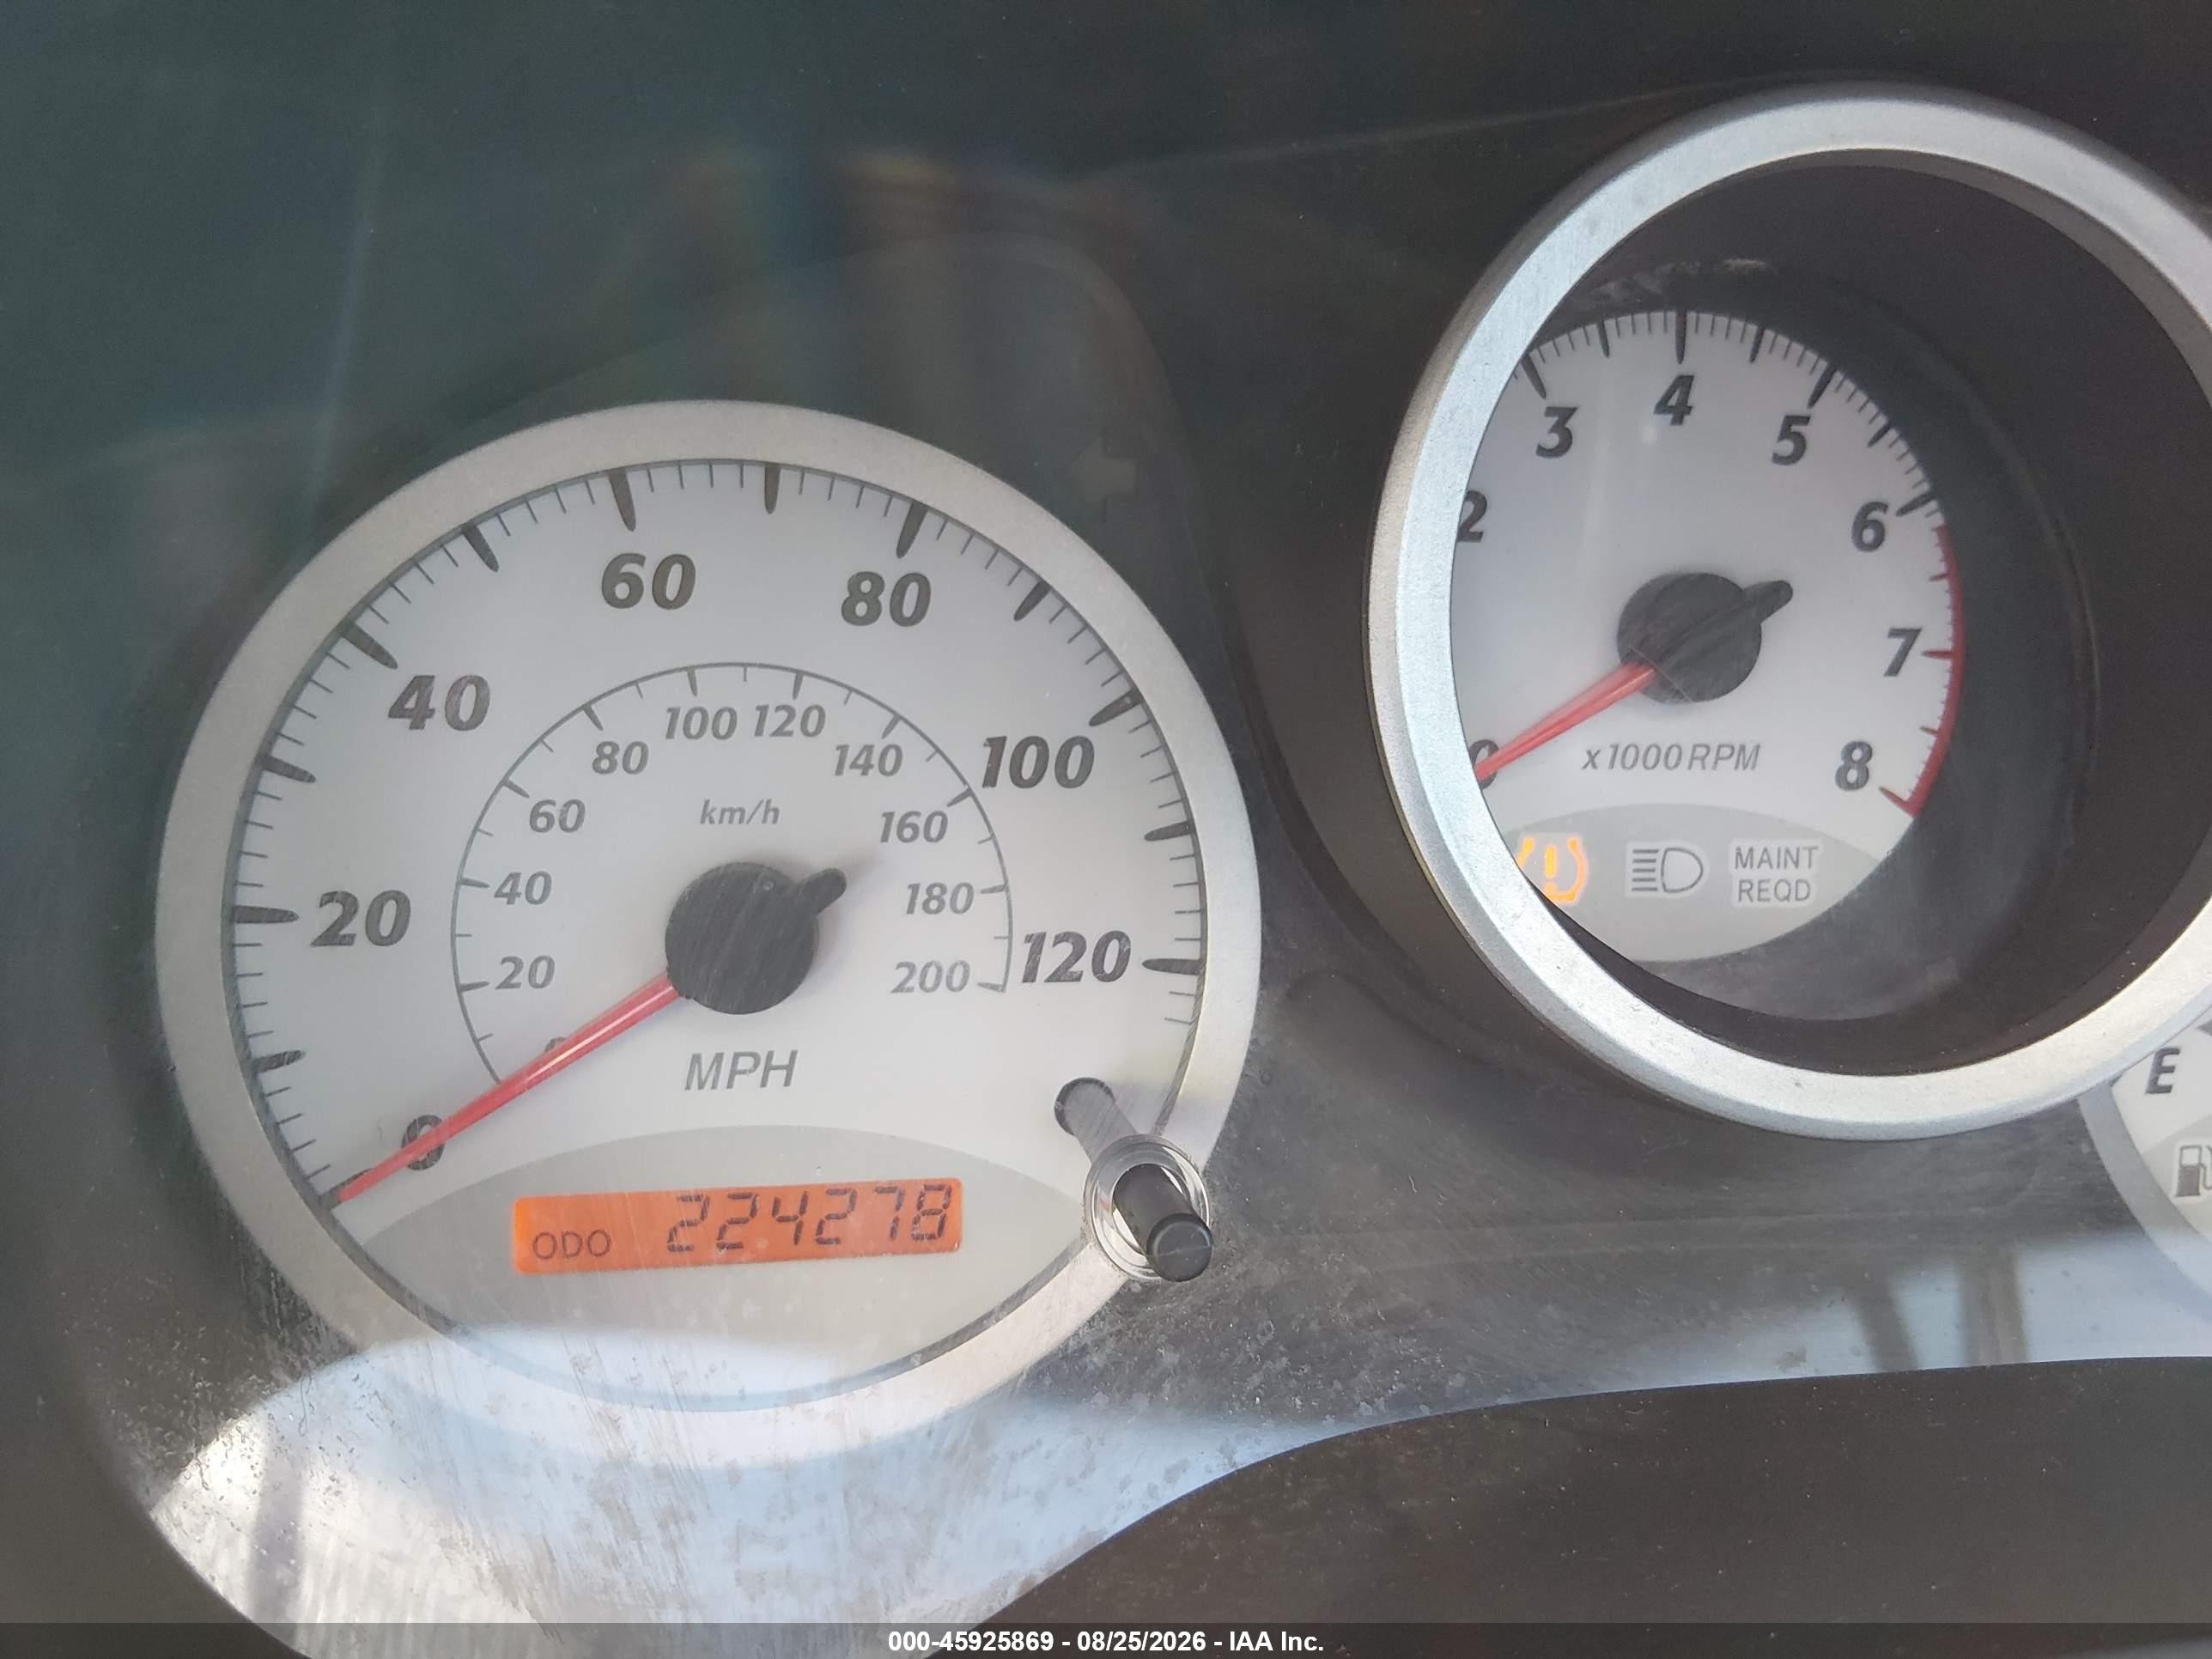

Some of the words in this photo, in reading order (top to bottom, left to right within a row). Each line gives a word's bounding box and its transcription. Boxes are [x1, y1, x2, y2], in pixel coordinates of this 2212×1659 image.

[1653, 374, 1694, 426] 4
[1534, 406, 1578, 459] 3
[1771, 416, 1811, 465] 5
[1456, 489, 1487, 543] 2
[1850, 501, 1888, 552] 6
[601, 553, 696, 609] 60
[841, 571, 931, 627] 80
[1882, 628, 1923, 678] 7
[387, 674, 490, 730] 40
[665, 706, 737, 739] 100
[754, 705, 825, 738] 120
[592, 741, 648, 775] 80
[835, 744, 902, 777] 140
[981, 735, 1094, 788] 100
[1834, 741, 1873, 791] 8
[529, 799, 585, 833] 60
[700, 799, 780, 825] km/h
[880, 811, 947, 843] 160
[1735, 845, 1819, 871] MAINT
[495, 872, 551, 905] 40
[906, 883, 974, 915] 180
[1737, 878, 1811, 902] REQD
[311, 890, 411, 947] 20
[495, 955, 555, 990] 20
[891, 961, 970, 994] 200
[1021, 930, 1131, 984] 120
[684, 1049, 798, 1091] MPH
[2144, 1047, 2181, 1094] E
[532, 1230, 611, 1260] ODO
[667, 1183, 951, 1252] 224278
